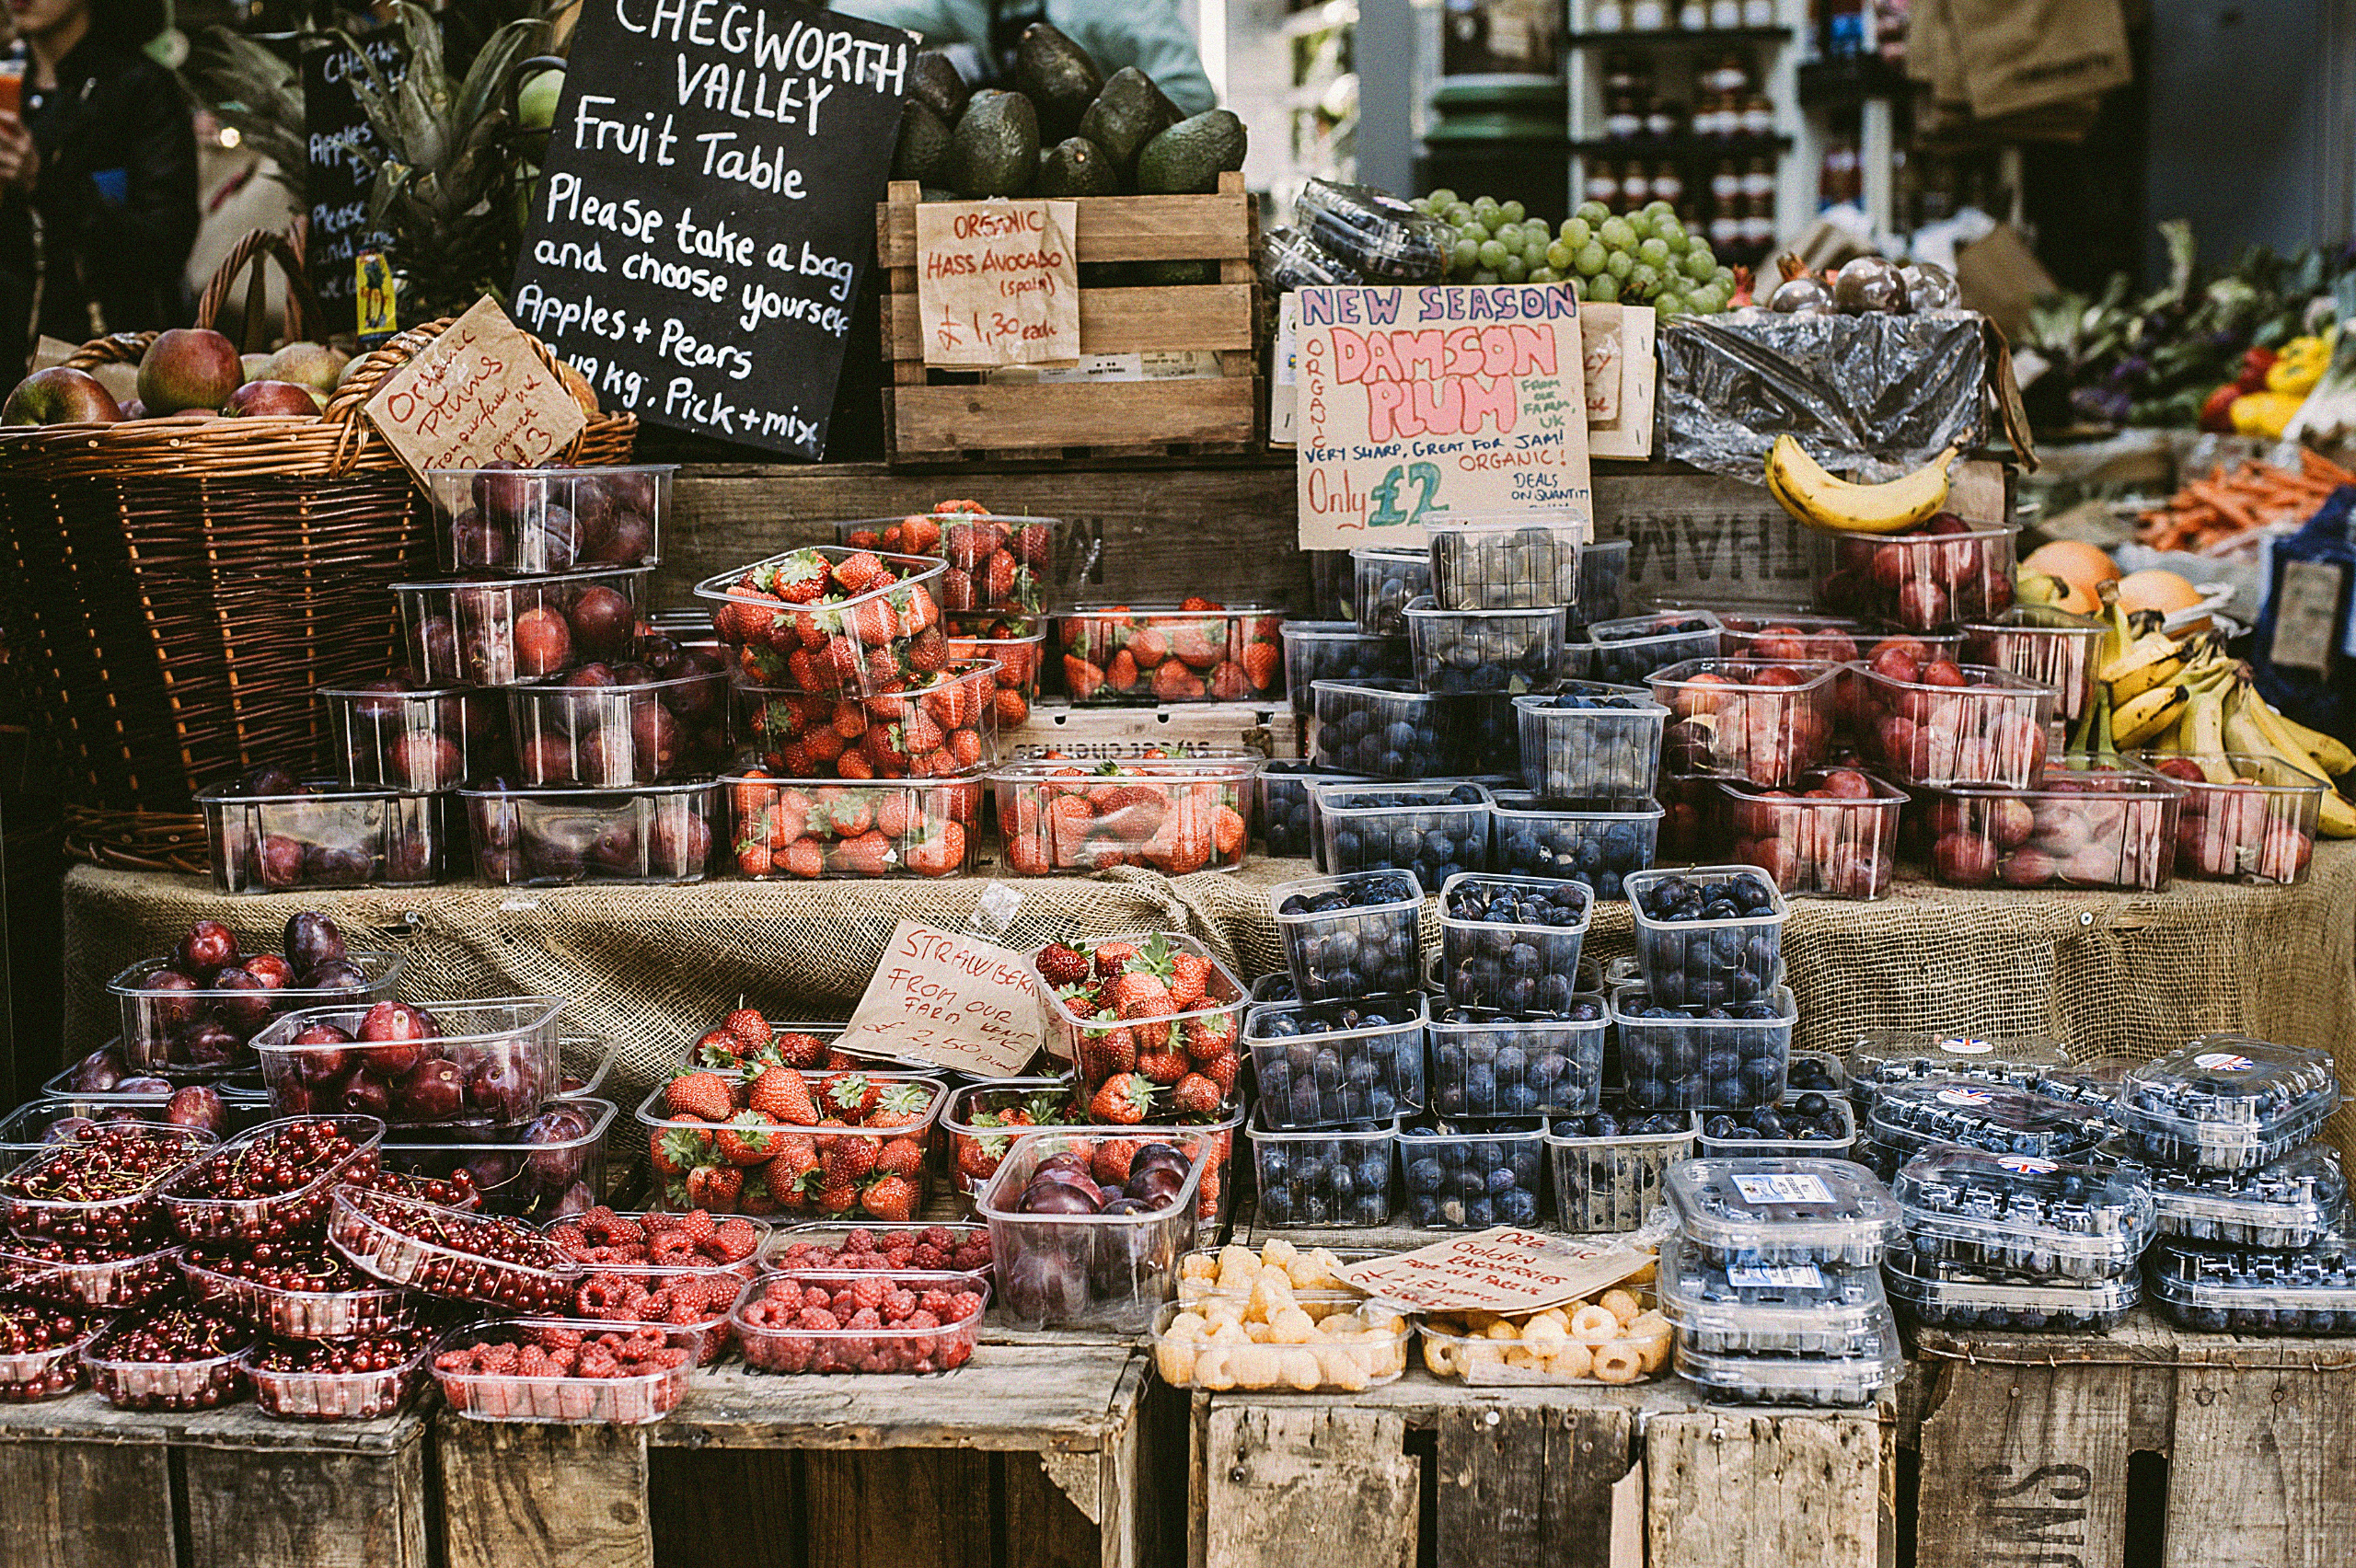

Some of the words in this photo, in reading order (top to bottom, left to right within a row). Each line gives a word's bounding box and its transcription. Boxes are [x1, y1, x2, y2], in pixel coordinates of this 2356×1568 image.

[616, 0, 907, 96] CHEGWORTH
[676, 53, 833, 136] VALLEY
[573, 96, 676, 167] Fruit
[697, 132, 807, 200] Table
[547, 173, 663, 244] Please
[675, 208, 753, 267] take
[766, 243, 795, 271] a
[799, 240, 854, 302] bag
[926, 251, 977, 280] HASS
[980, 248, 1062, 274] AVOCADO
[534, 239, 605, 273] and
[622, 249, 729, 303] choose
[739, 283, 849, 339] yourself
[1300, 287, 1402, 326] NEW
[1418, 282, 1577, 323] SEASON
[515, 282, 627, 341] Apples
[659, 317, 753, 379] Pears
[1331, 323, 1558, 385] DAMSON
[416, 355, 504, 439] Plums
[664, 375, 734, 435] Pick
[1305, 338, 1326, 449] ORGANIC
[1368, 374, 1518, 444] PLUM
[1520, 378, 1561, 393] FROM
[1533, 390, 1556, 401] OUR
[1304, 446, 1346, 463] VERY
[1412, 441, 1465, 457] GREAT
[1472, 437, 1506, 451] FOR
[1514, 429, 1564, 450] JAM!
[1539, 414, 1565, 429] UK
[1308, 467, 1367, 531] Only
[1368, 461, 1450, 528] £2
[1510, 490, 1532, 501] ON
[1513, 471, 1559, 489] DEALS
[887, 967, 957, 1006] FROM
[965, 1000, 1012, 1023] OUR
[904, 997, 961, 1025] FARM
[1495, 1232, 1598, 1261] ORGIC
